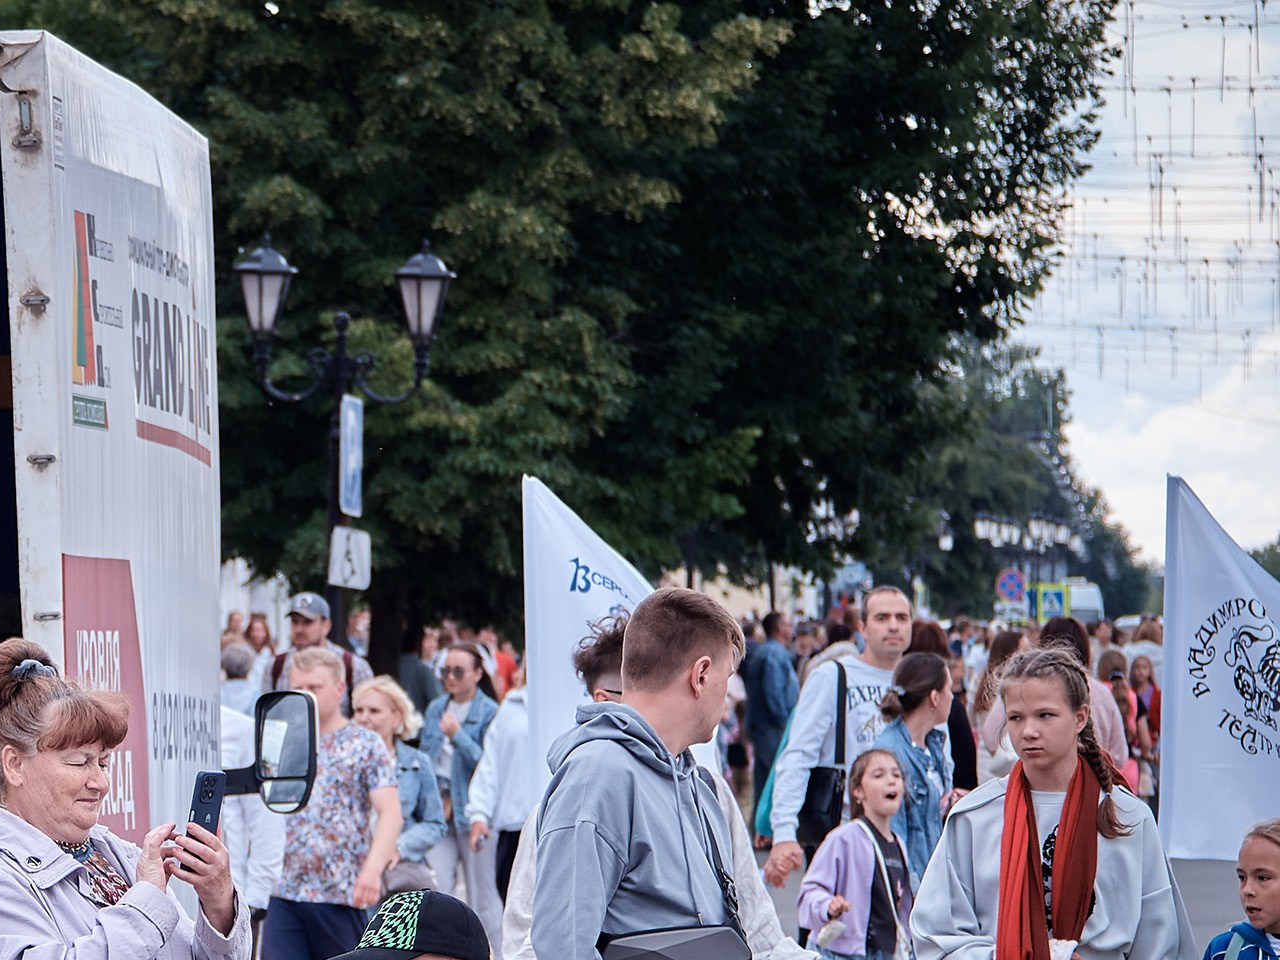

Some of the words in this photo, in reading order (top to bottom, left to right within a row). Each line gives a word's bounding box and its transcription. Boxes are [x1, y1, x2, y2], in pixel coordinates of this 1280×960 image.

[132, 287, 184, 417] GRAND
[569, 557, 636, 606] ВСЕР
[77, 630, 121, 692] КРОВЛЯ
[1188, 598, 1266, 698] ВЛАДИМИРС
[152, 692, 159, 761] 8
[847, 685, 883, 711] EXPL
[1218, 709, 1273, 755] ТЕАТР
[101, 750, 136, 831] САД
